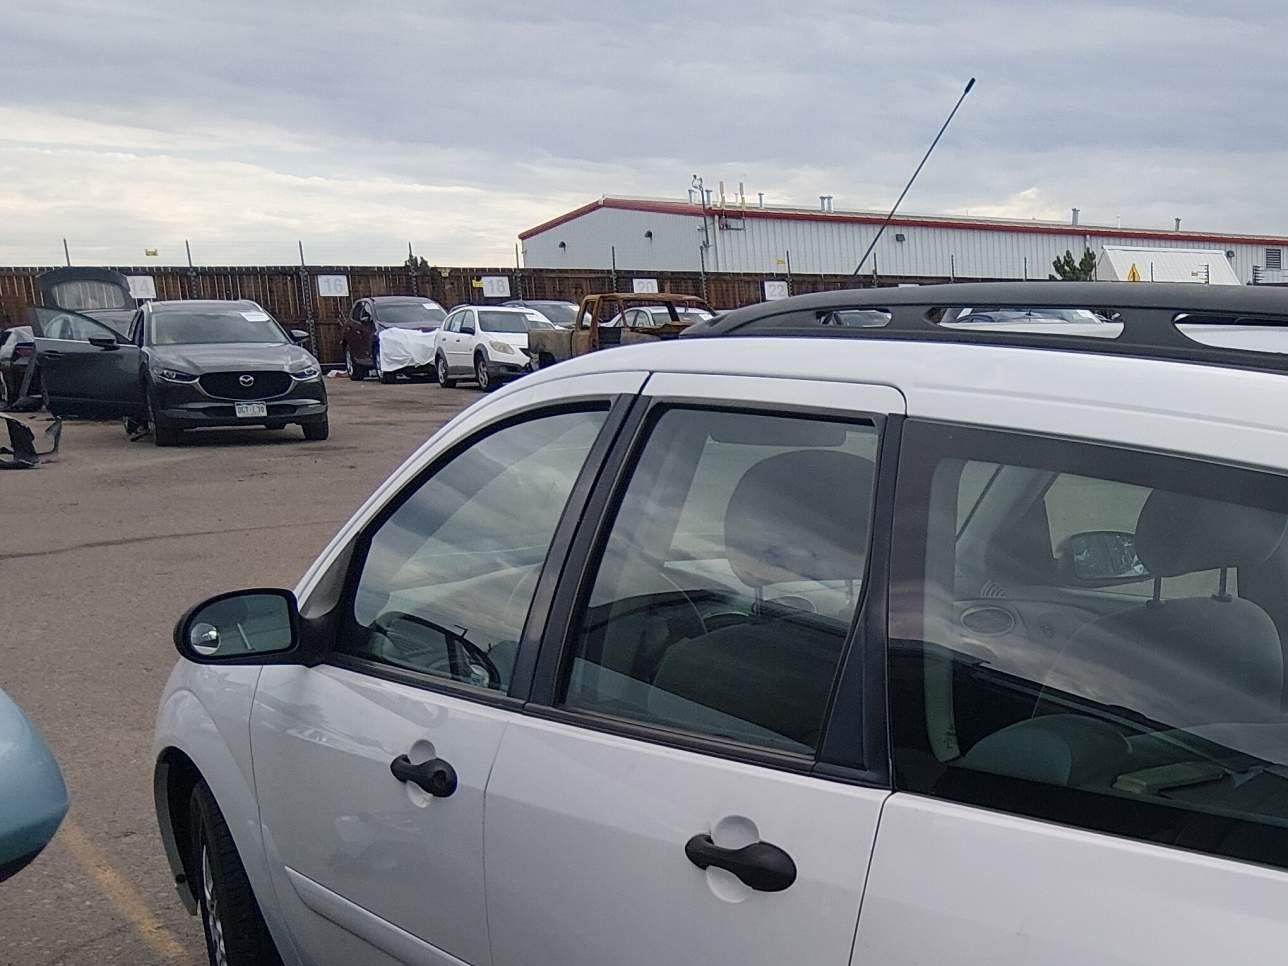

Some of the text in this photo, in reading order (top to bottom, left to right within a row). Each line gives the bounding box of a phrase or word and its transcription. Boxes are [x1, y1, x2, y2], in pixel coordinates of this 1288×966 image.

[324, 278, 343, 294] 16
[488, 279, 505, 294] 18
[637, 280, 655, 293] 20
[768, 284, 785, 297] 22
